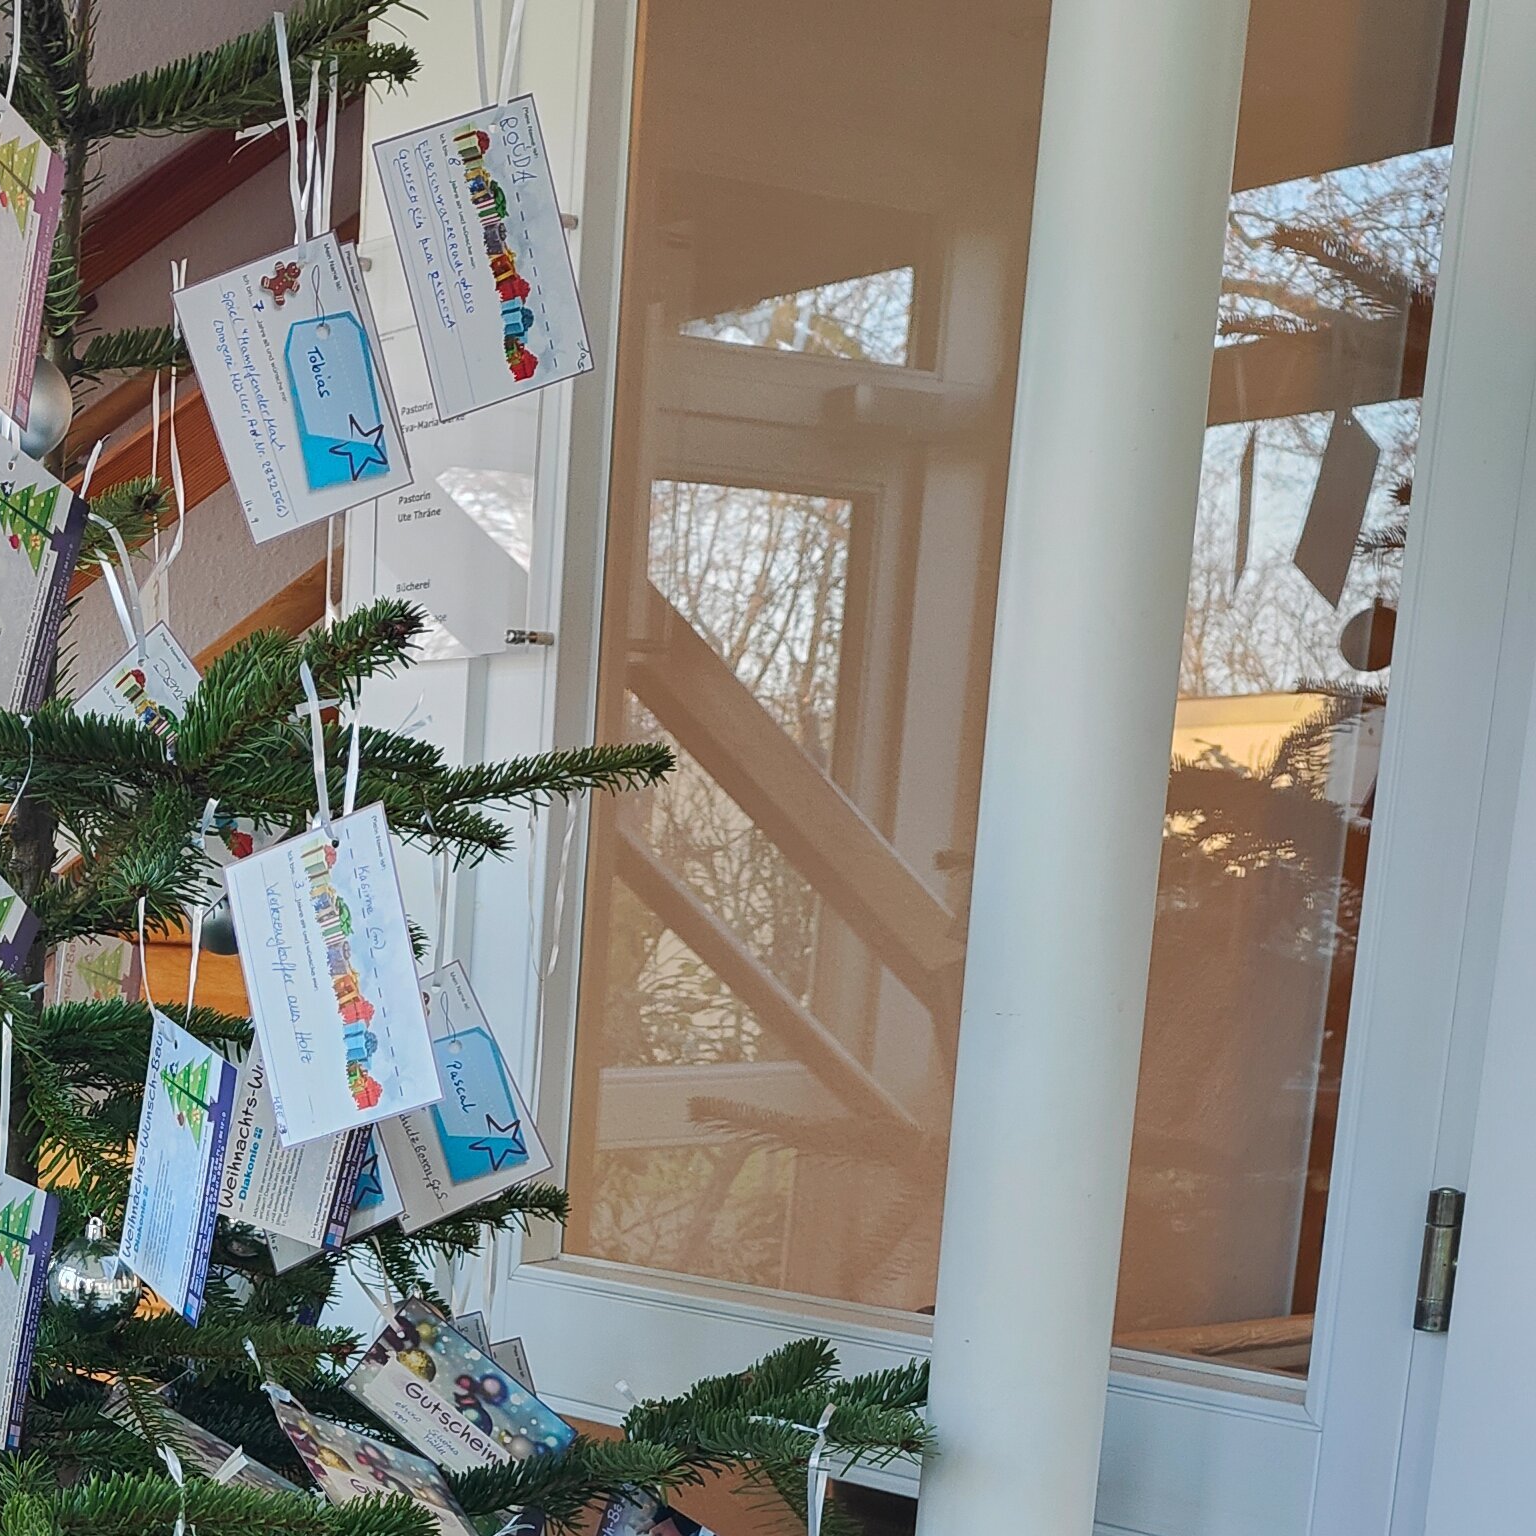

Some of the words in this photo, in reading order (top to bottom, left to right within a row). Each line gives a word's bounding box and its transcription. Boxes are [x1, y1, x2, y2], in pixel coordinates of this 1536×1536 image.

[251, 299, 265, 313] 7
[305, 344, 333, 399] Tobias
[397, 511, 412, 523] Ute
[398, 491, 431, 505] Pastorin
[396, 579, 431, 593] Bücherei
[445, 1060, 476, 1113] Pascal
[218, 1063, 263, 1208] Weihnachts-W
[239, 1141, 259, 1200] Diakonie
[133, 1198, 146, 1253] Diakonie
